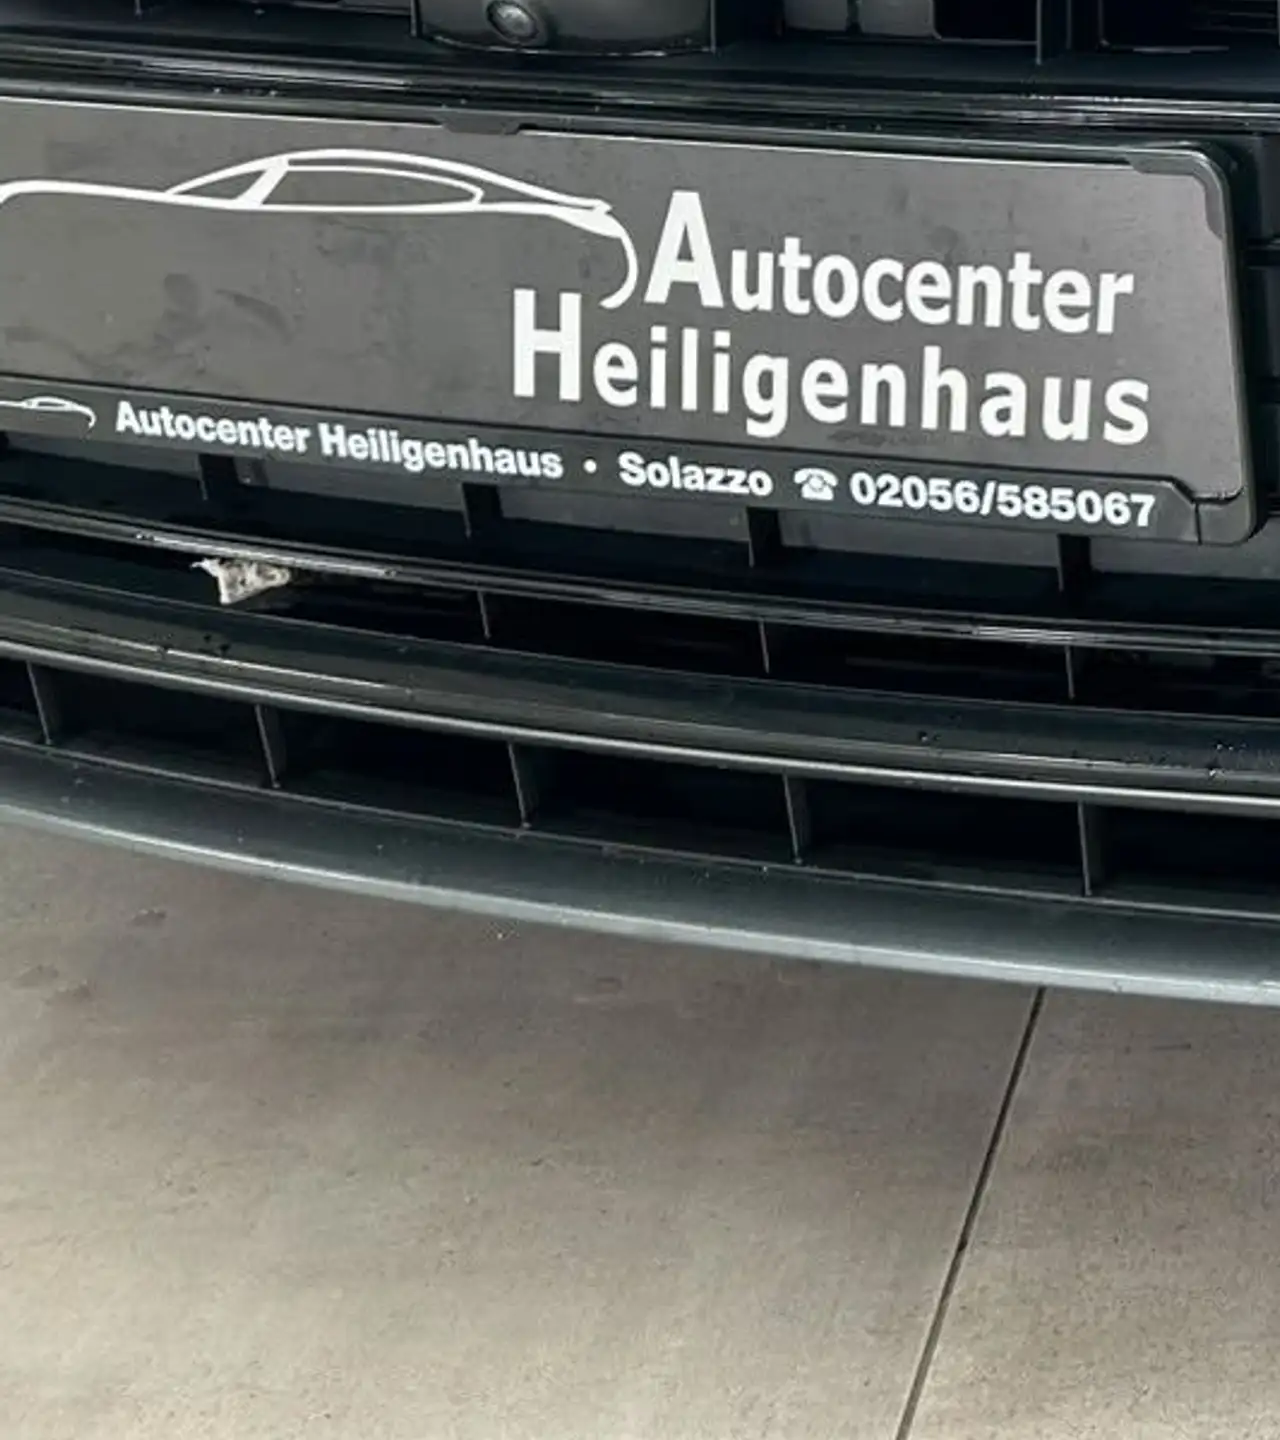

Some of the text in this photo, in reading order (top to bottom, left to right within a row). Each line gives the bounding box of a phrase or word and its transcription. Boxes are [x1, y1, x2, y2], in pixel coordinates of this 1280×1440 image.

[643, 190, 1135, 335] Autocenter
[511, 288, 1150, 446] Heiligenhaus
[115, 400, 1156, 528] Autocenter Heiligenhaus Solazzo 02056/585067
